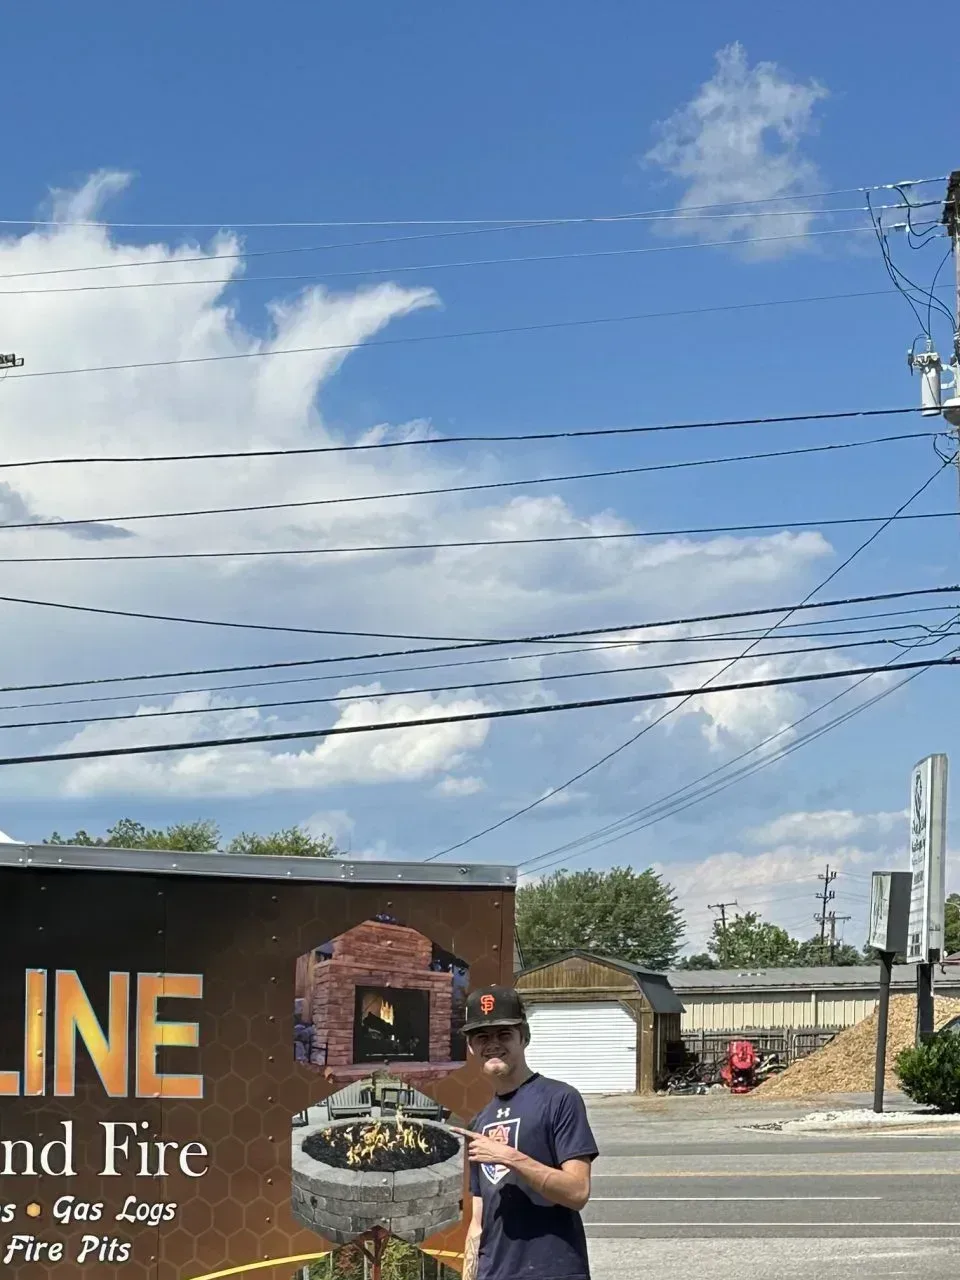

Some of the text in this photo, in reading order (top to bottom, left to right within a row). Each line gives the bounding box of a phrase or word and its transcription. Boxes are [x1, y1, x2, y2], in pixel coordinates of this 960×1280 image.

[97, 1120, 209, 1178] Fire
[52, 1195, 103, 1222] Gas
[115, 1196, 177, 1226] Logs
[3, 1235, 64, 1265] Fire
[76, 1235, 132, 1263] Pits
